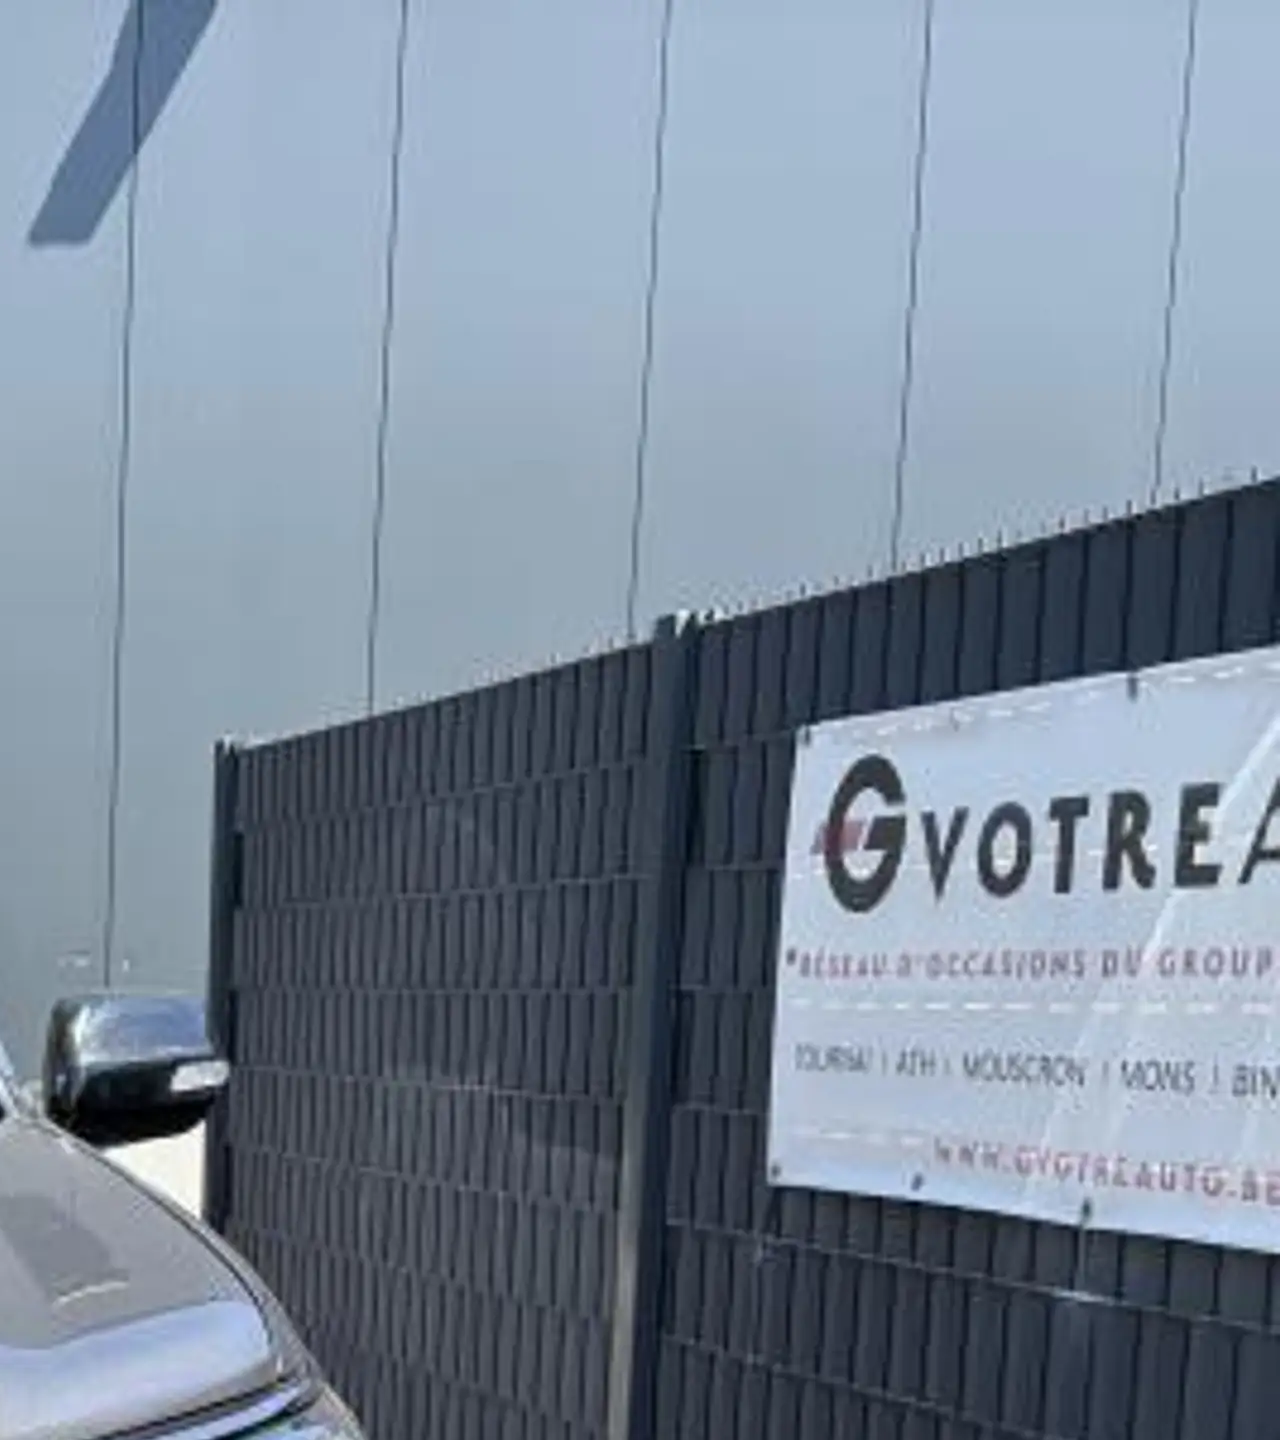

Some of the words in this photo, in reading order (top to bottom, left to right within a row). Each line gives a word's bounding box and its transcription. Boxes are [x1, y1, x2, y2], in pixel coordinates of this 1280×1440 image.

[1101, 949, 1143, 979] DU
[895, 1048, 938, 1077] ATH
[1120, 1058, 1196, 1096] MONS
